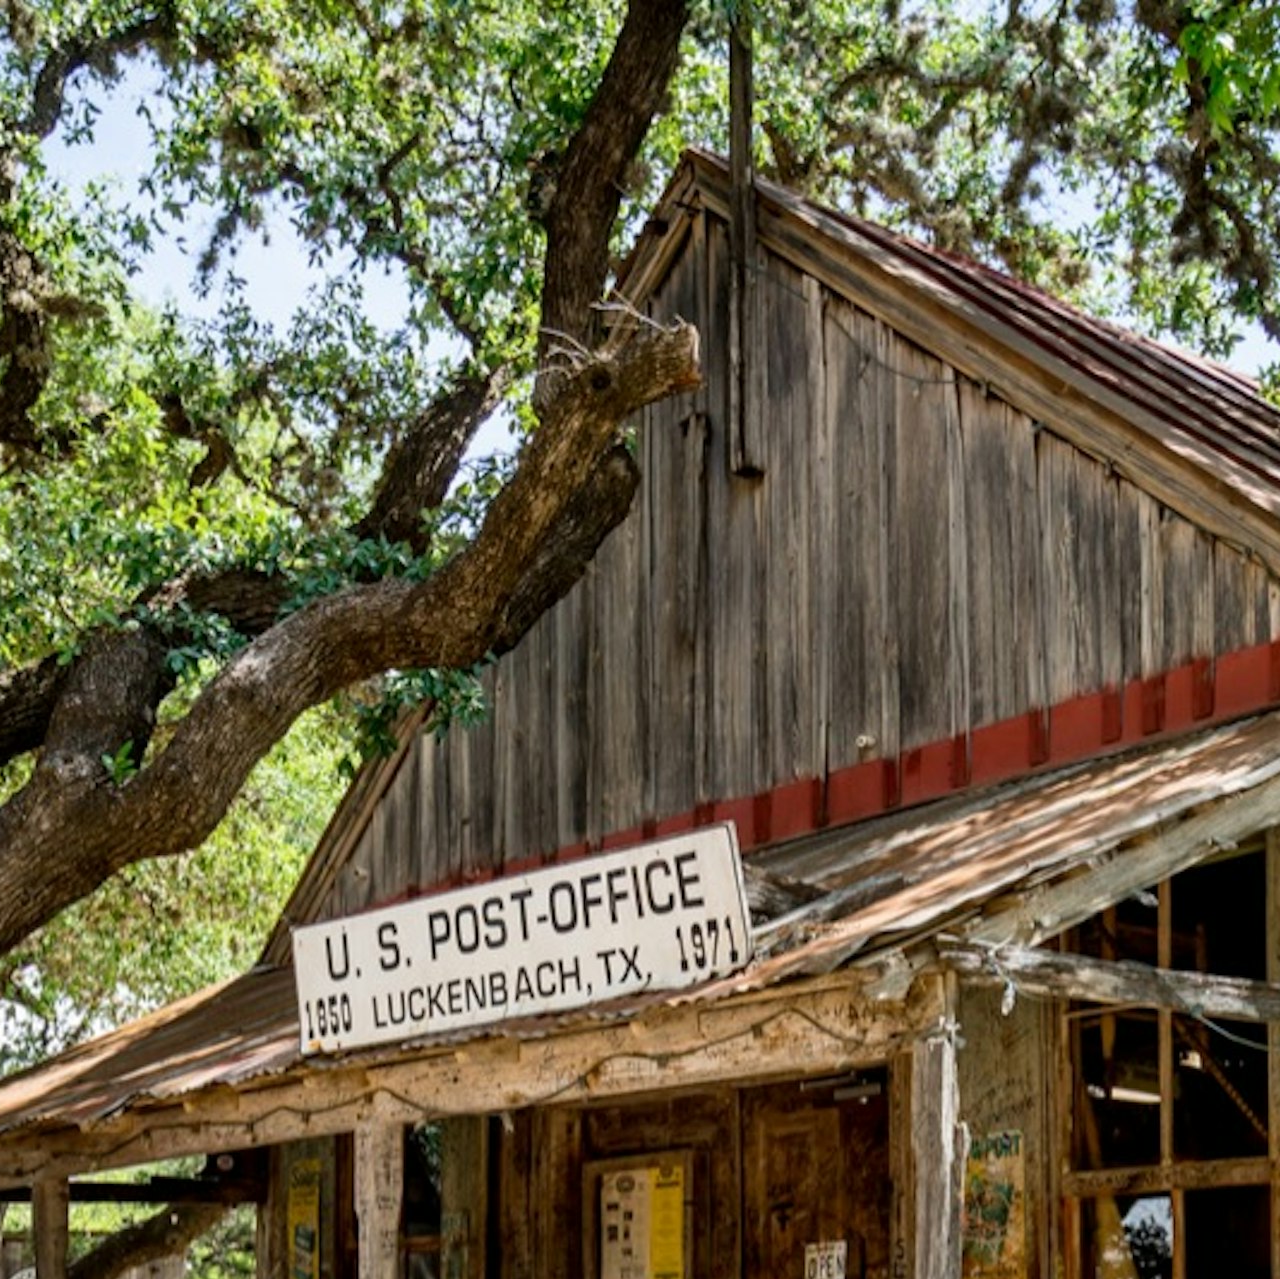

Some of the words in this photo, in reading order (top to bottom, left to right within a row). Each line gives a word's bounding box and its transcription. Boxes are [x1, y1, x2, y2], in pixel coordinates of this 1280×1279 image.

[305, 992, 352, 1040] 1850
[372, 957, 593, 1029] LUCKENBACH,
[597, 944, 653, 988] TX,
[675, 916, 740, 974] 1971
[325, 932, 361, 982] U.
[376, 922, 412, 971] S.
